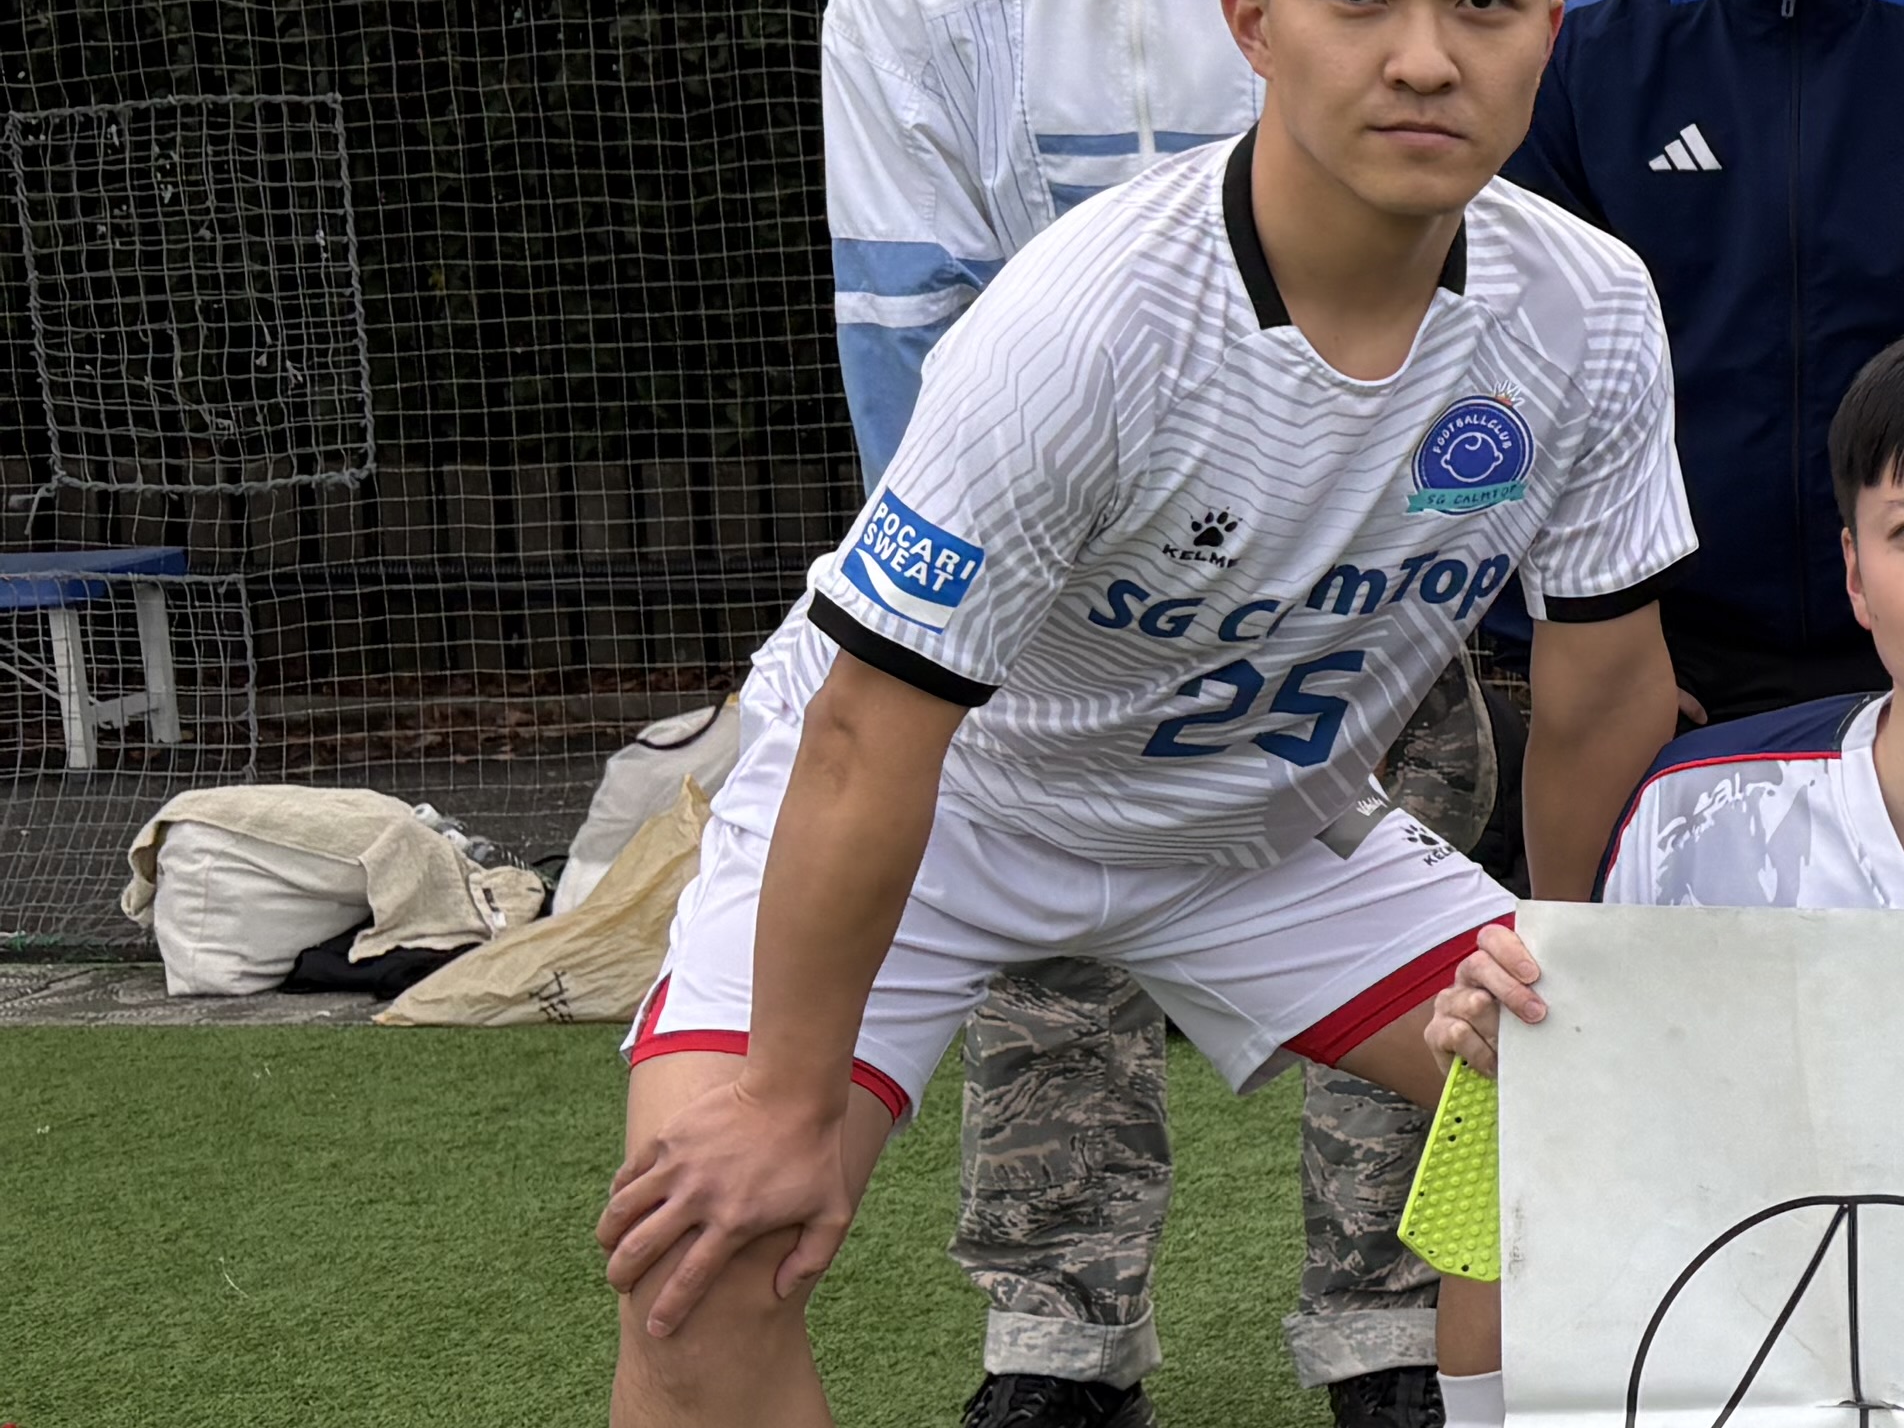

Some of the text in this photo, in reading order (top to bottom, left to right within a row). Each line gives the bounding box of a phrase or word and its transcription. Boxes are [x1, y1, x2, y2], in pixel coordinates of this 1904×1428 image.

[863, 522, 955, 592] SWEAT
[872, 502, 977, 581] POCARI
[1088, 578, 1205, 639] SG
[1141, 649, 1367, 768] 25
[1423, 845, 1456, 867] KEL
